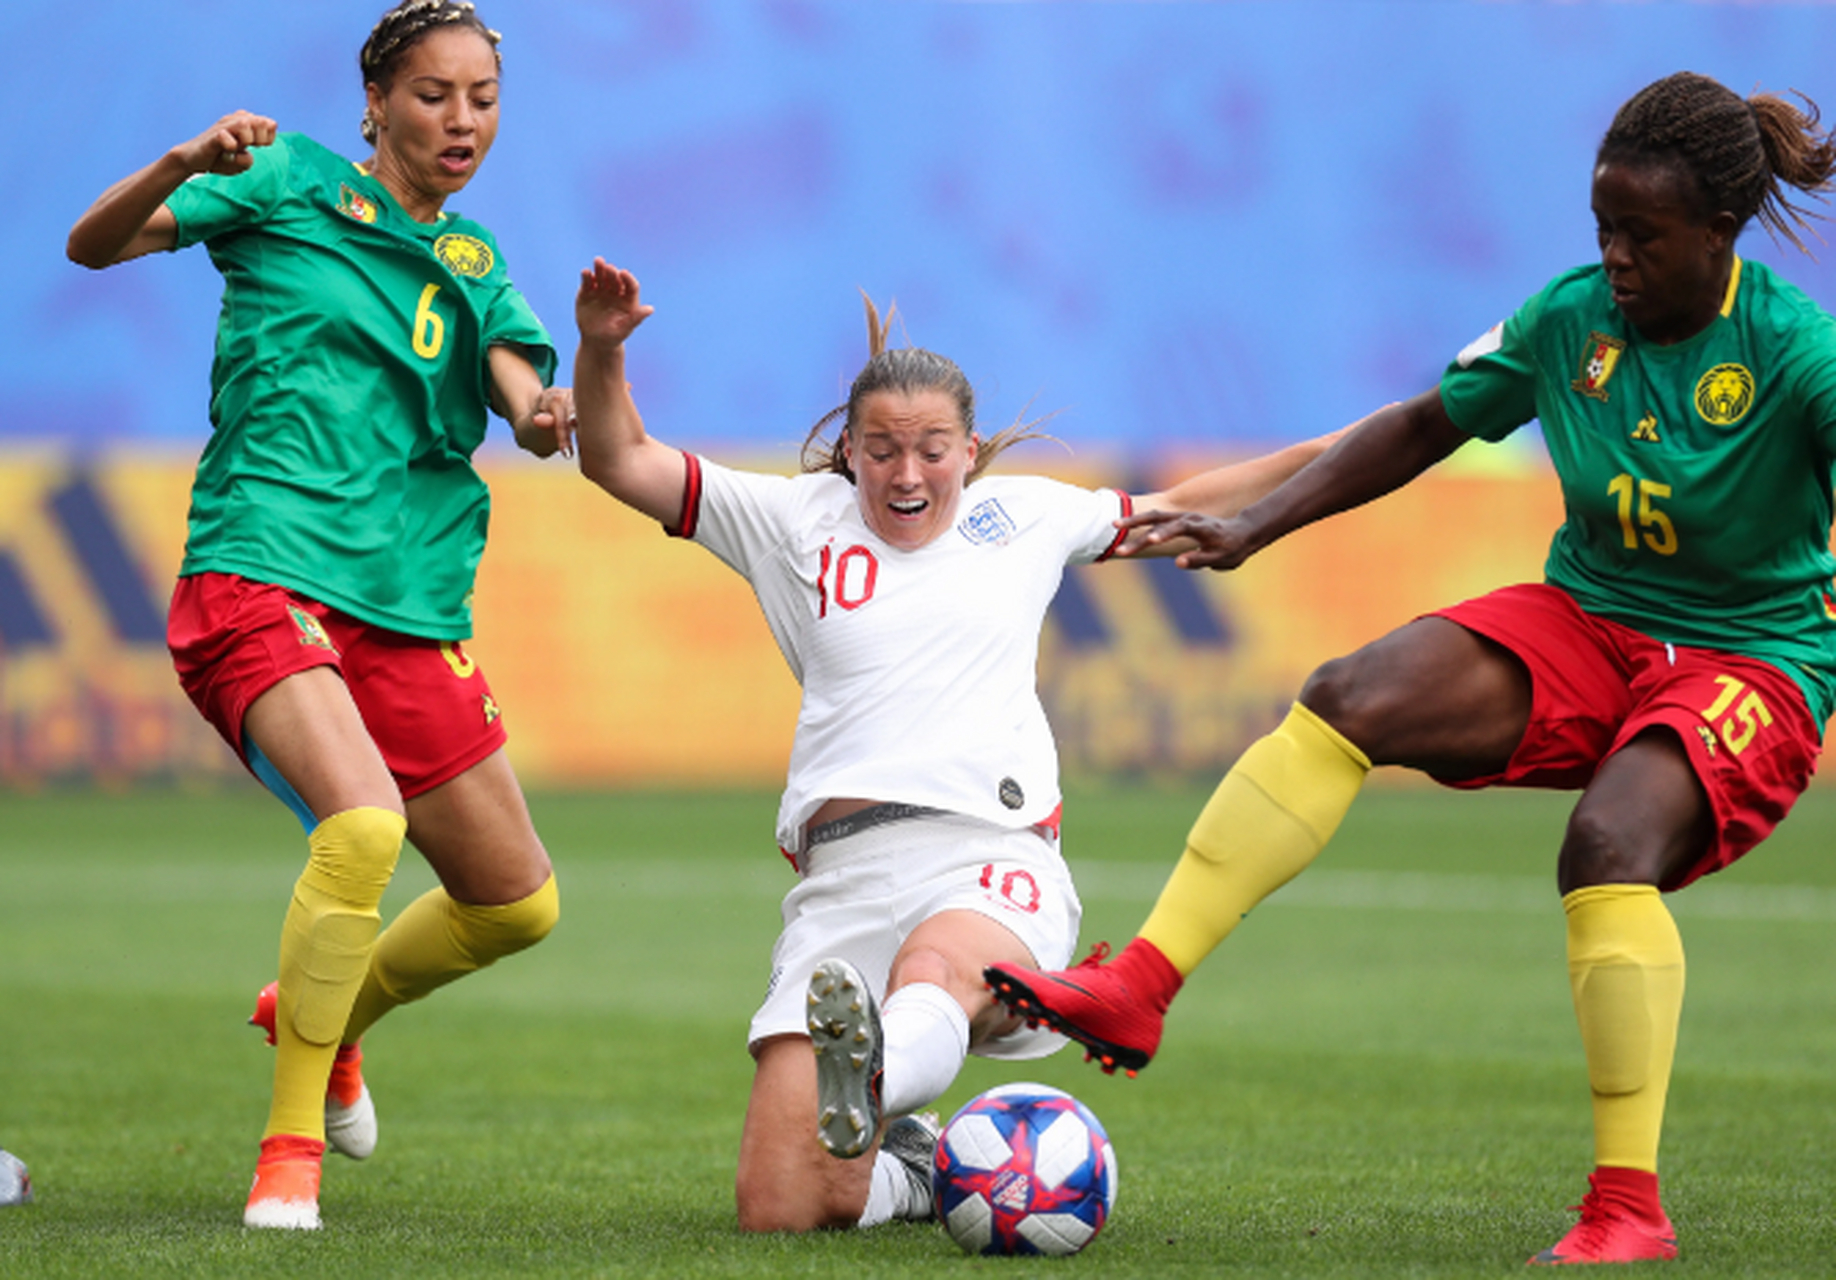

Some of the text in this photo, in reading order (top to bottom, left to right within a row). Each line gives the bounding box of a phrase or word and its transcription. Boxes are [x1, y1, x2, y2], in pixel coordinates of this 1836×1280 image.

[412, 283, 444, 359] 6
[1607, 473, 1678, 556] 15
[817, 537, 878, 619] 10
[1701, 674, 1773, 756] 15
[979, 864, 1041, 913] 10
